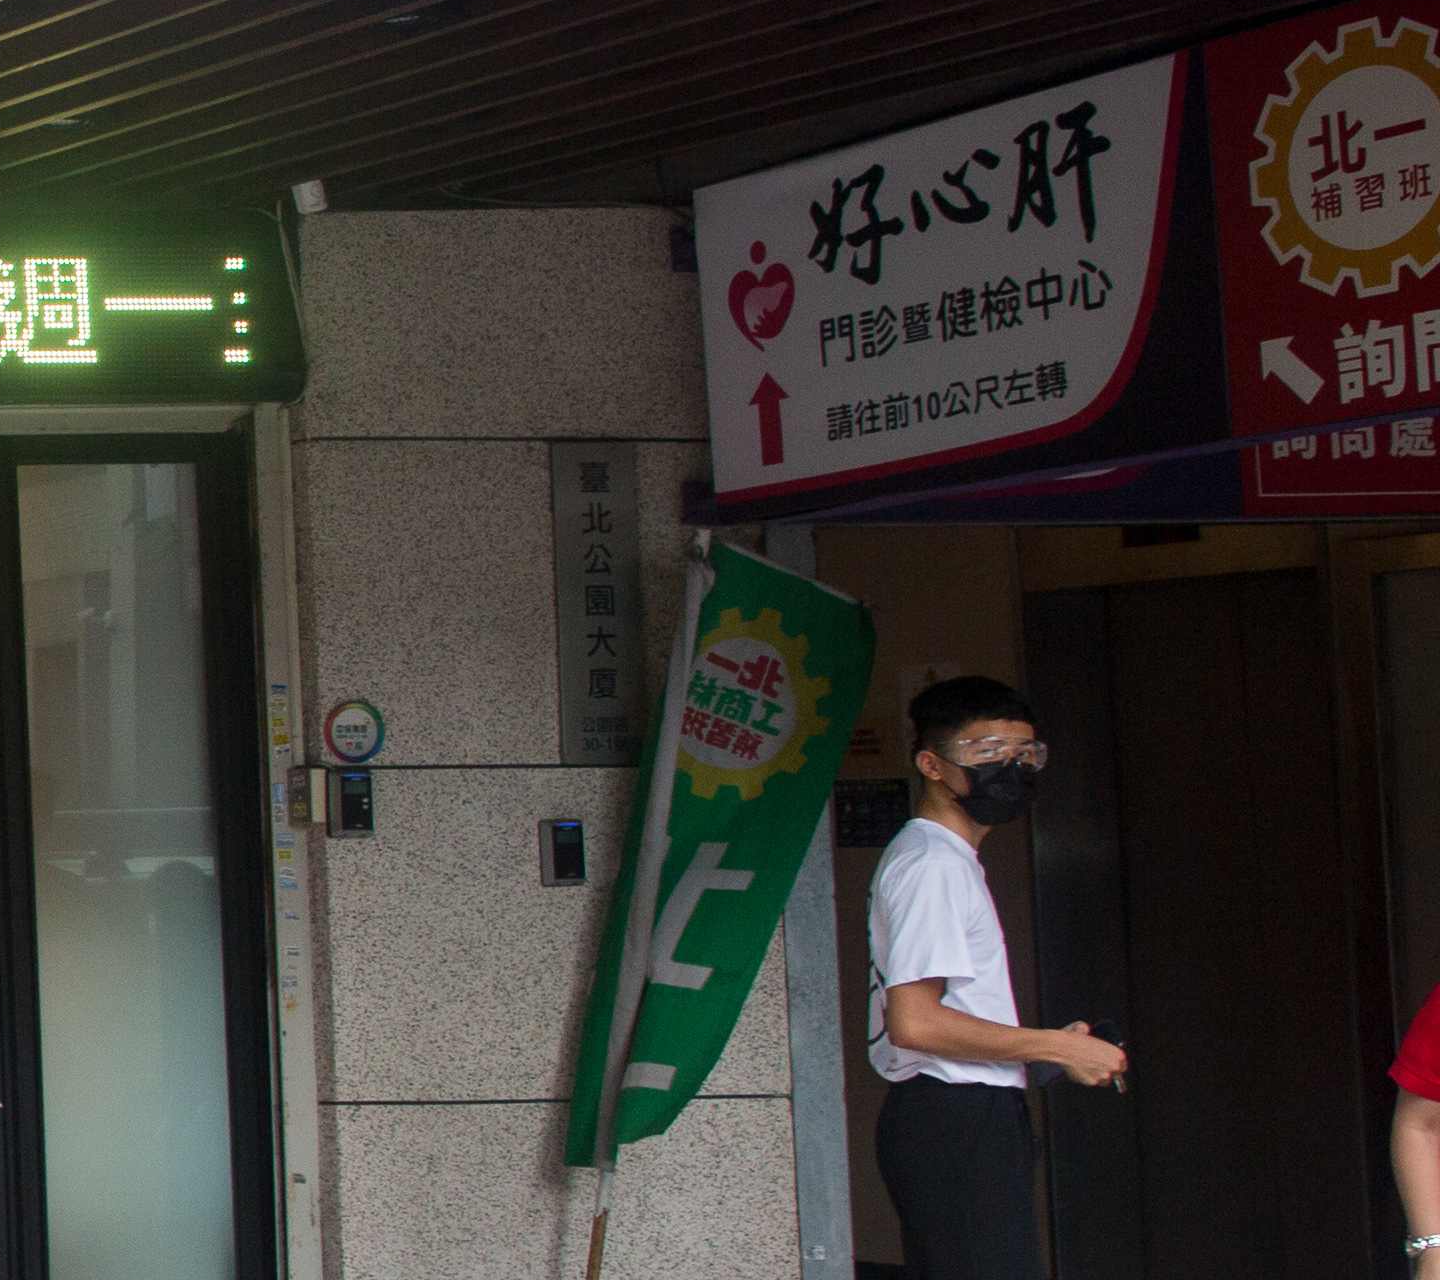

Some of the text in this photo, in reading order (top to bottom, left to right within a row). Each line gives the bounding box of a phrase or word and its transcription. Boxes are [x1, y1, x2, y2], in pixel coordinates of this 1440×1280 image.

[807, 100, 1111, 285] 好心肝
[1308, 110, 1427, 183] 北一
[1311, 163, 1433, 221] 補習班
[819, 259, 1113, 367] 門診暨健檢中心
[826, 360, 1069, 442] 請往前10公尺左轉
[580, 461, 618, 699] 臺北公園大廈
